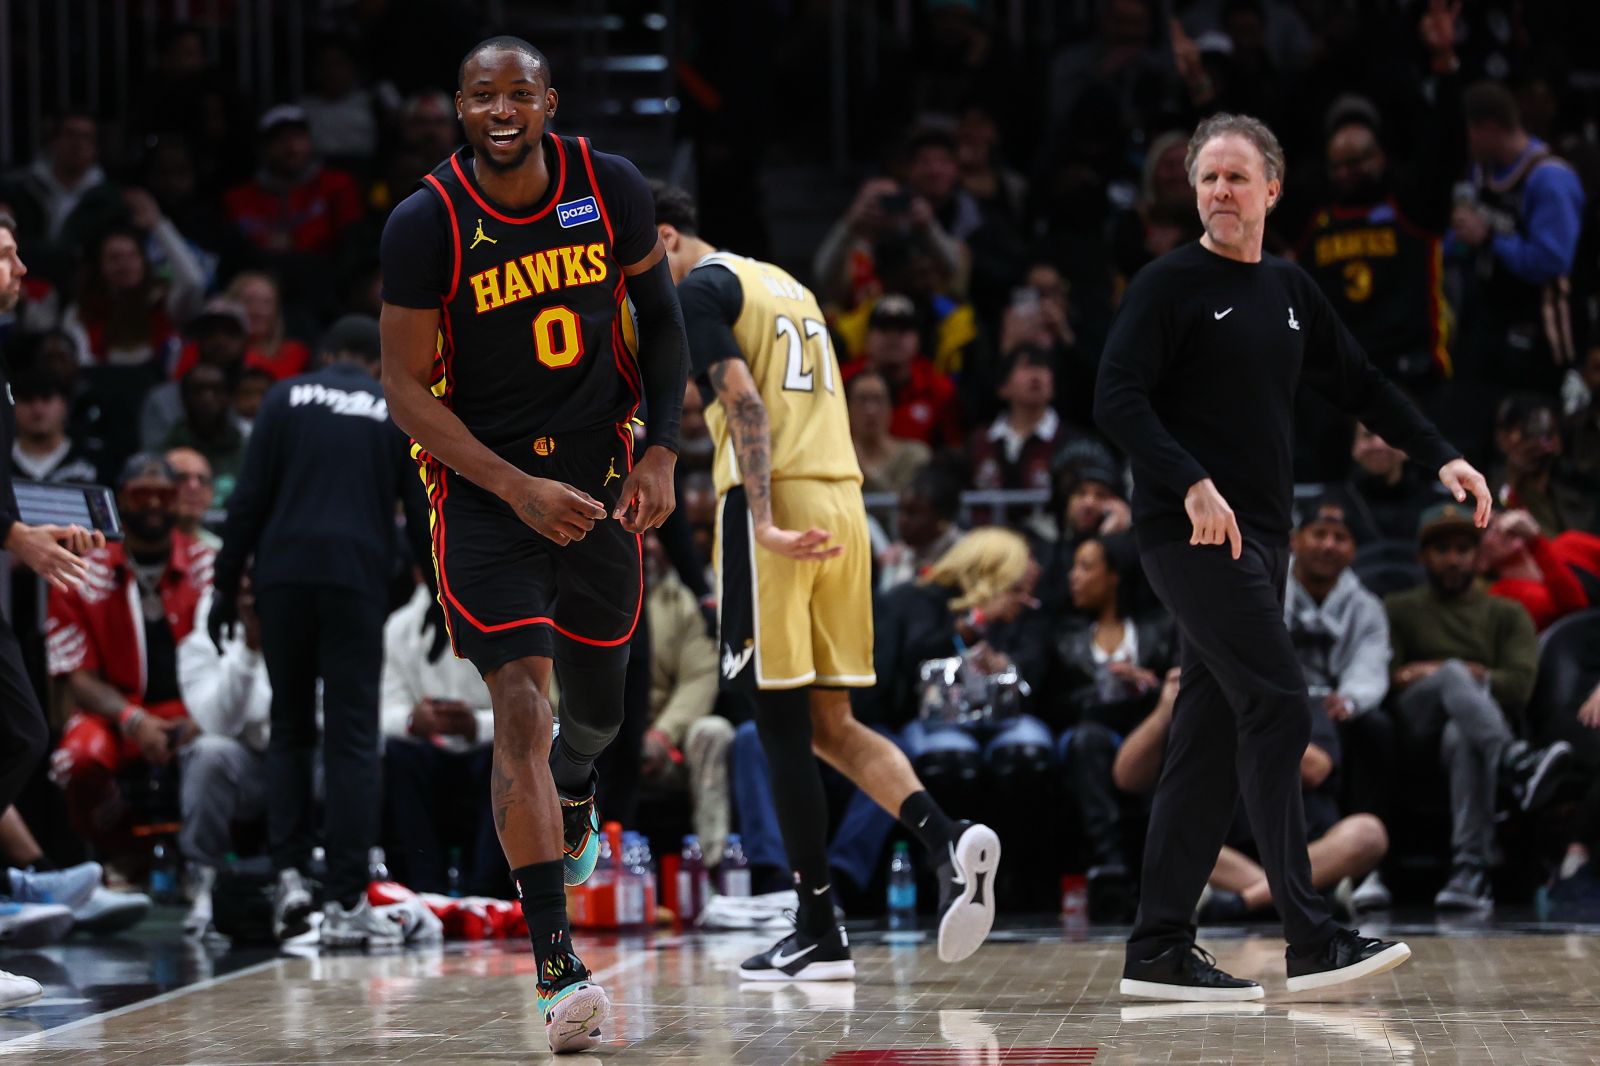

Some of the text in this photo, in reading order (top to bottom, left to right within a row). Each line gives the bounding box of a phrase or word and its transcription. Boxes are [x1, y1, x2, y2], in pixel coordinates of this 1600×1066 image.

[561, 203, 594, 222] paze
[470, 243, 607, 314] HAWKS
[532, 305, 584, 370] 0
[775, 314, 835, 396] 27
